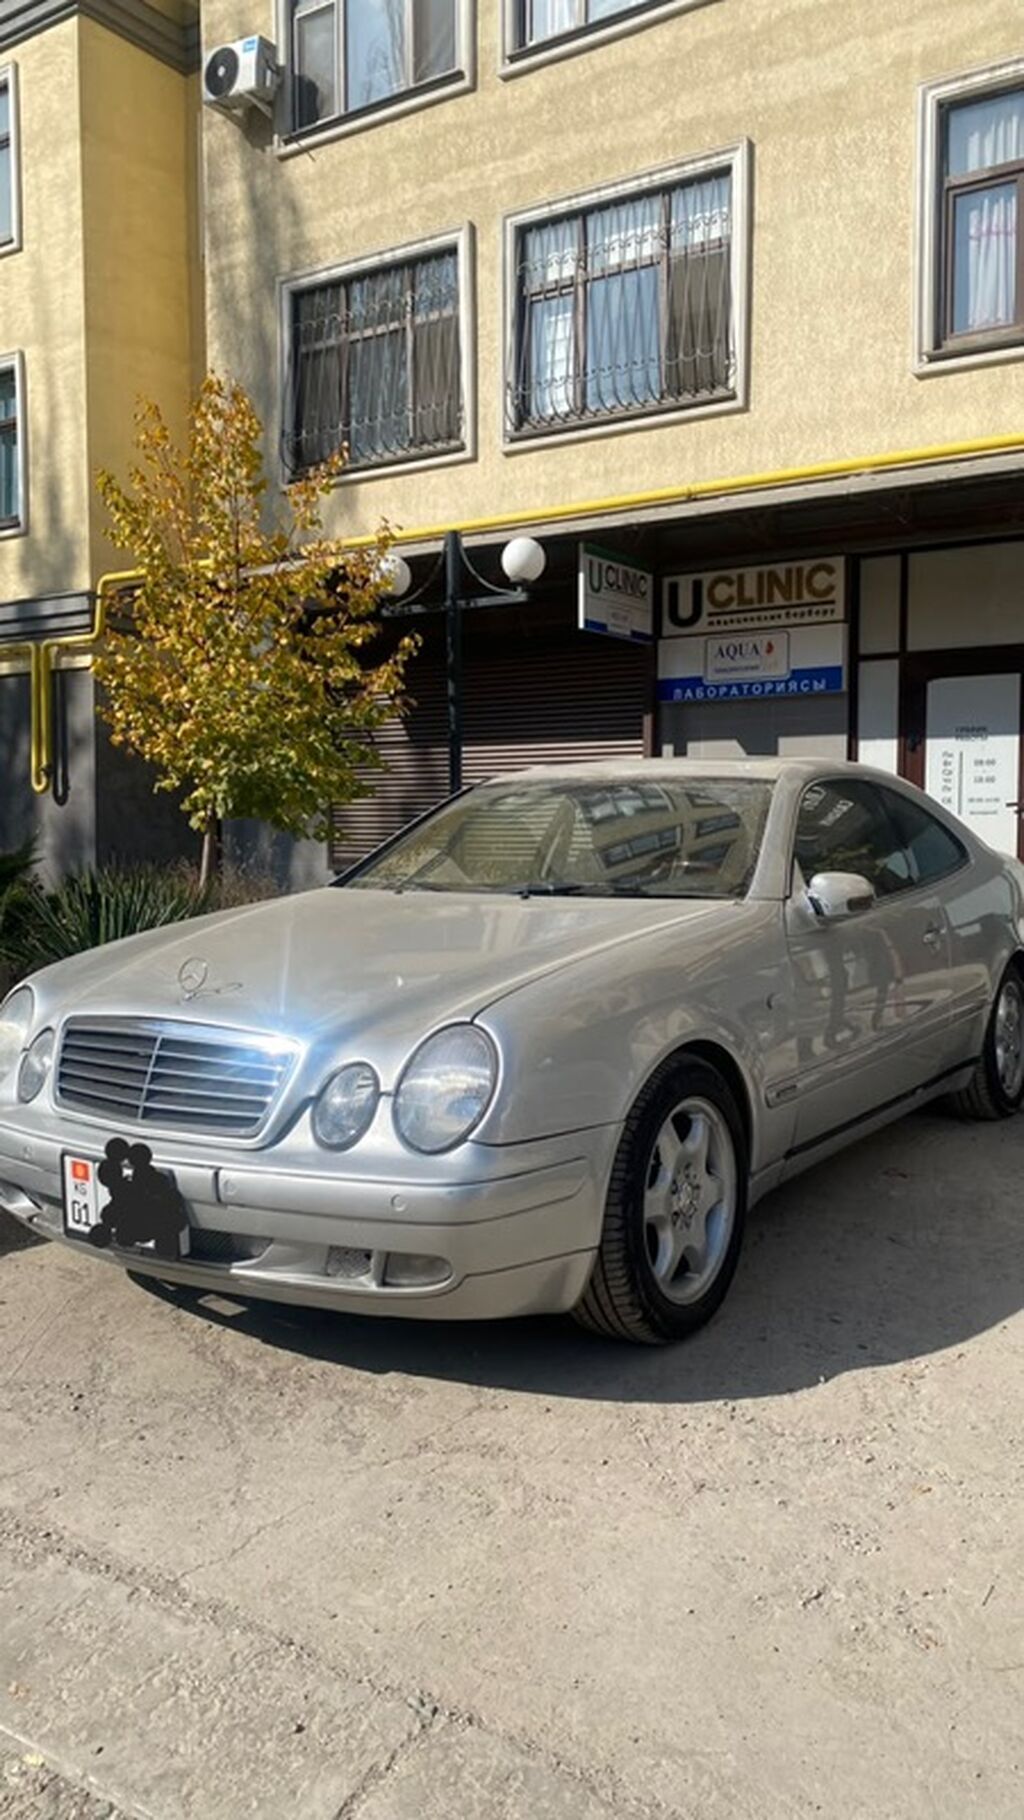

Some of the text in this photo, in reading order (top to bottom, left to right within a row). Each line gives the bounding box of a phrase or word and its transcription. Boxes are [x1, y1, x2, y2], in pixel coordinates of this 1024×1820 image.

[714, 642, 760, 661] AQUA
[673, 679, 827, 700] ЛАБОРАТОРИЯСЫ
[74, 1182, 87, 1195] KG
[72, 1200, 91, 1227] 01
